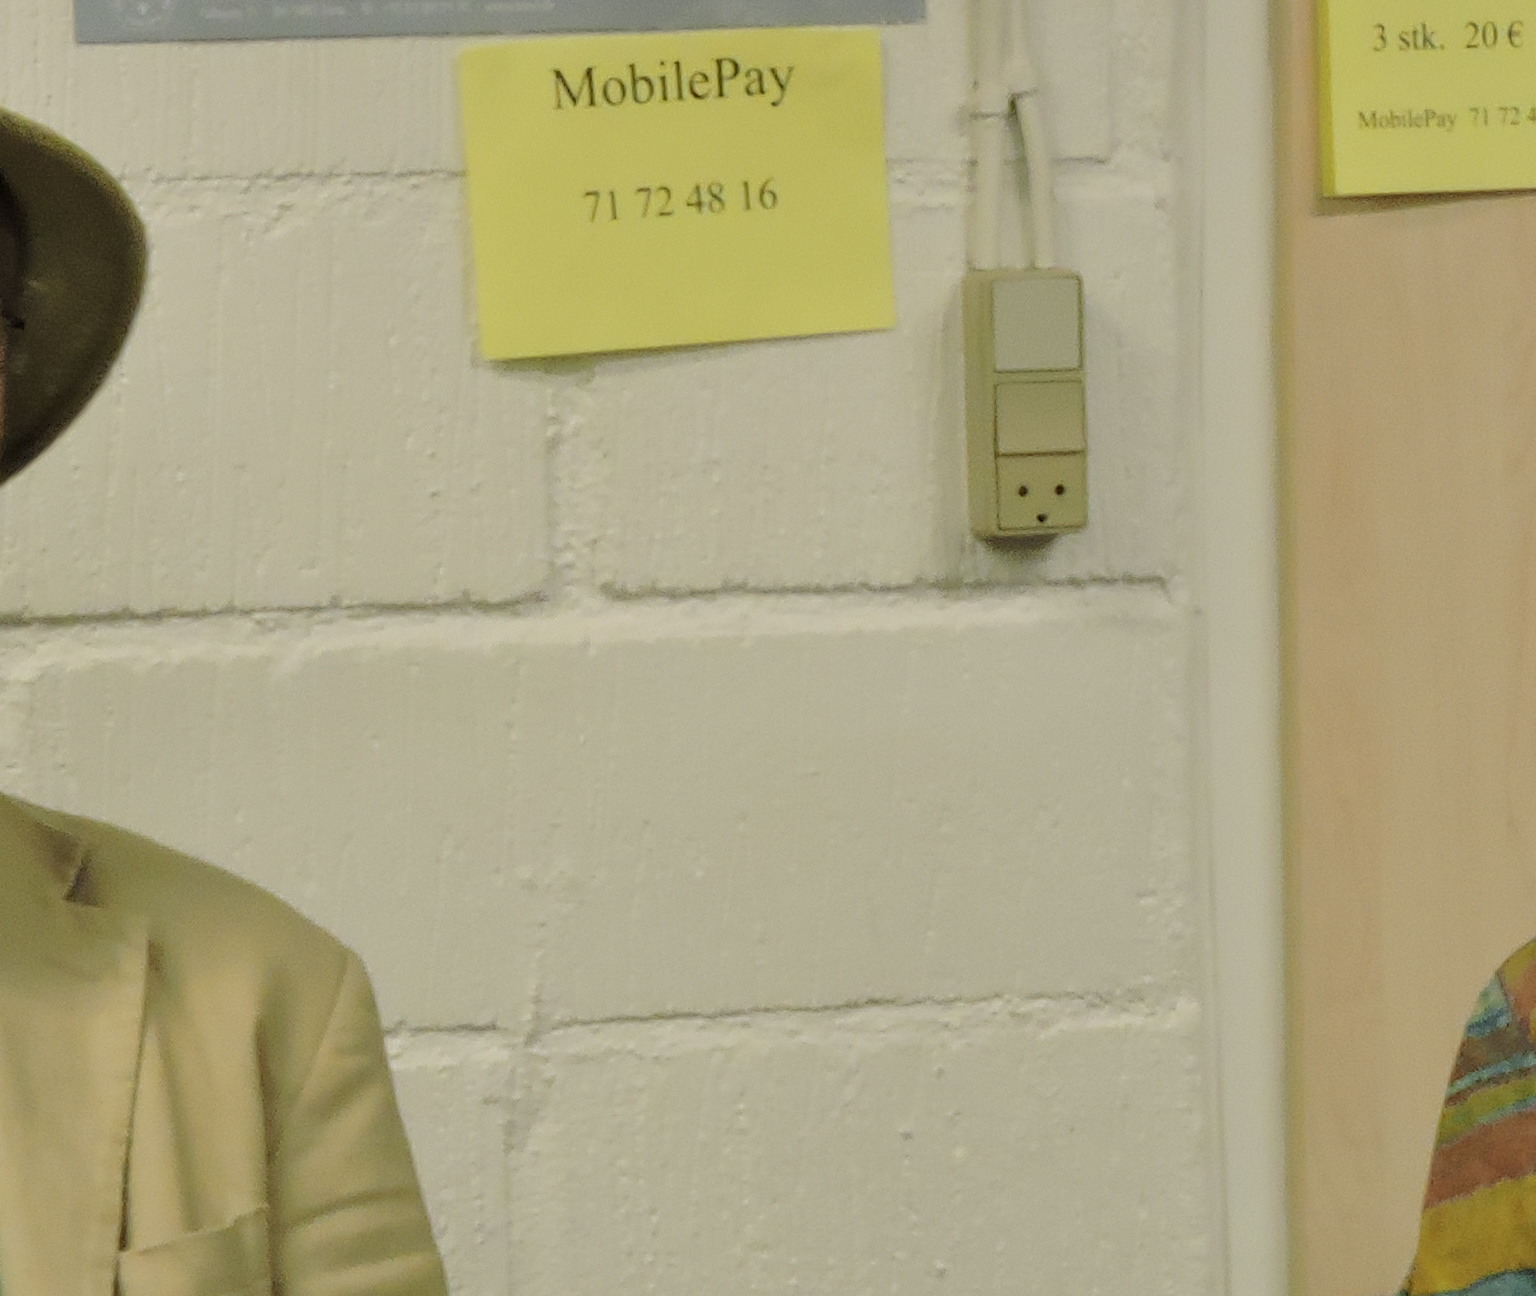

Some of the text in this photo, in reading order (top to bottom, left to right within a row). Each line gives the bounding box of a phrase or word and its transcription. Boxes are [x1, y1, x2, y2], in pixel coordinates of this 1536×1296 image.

[1372, 19, 1525, 51] 3 stk. 20 €
[551, 56, 796, 111] MobilePay
[1357, 107, 1458, 135] MobilePay
[1467, 106, 1490, 127] 71
[1498, 105, 1521, 126] 72
[583, 176, 779, 222] 71 72 48 16
